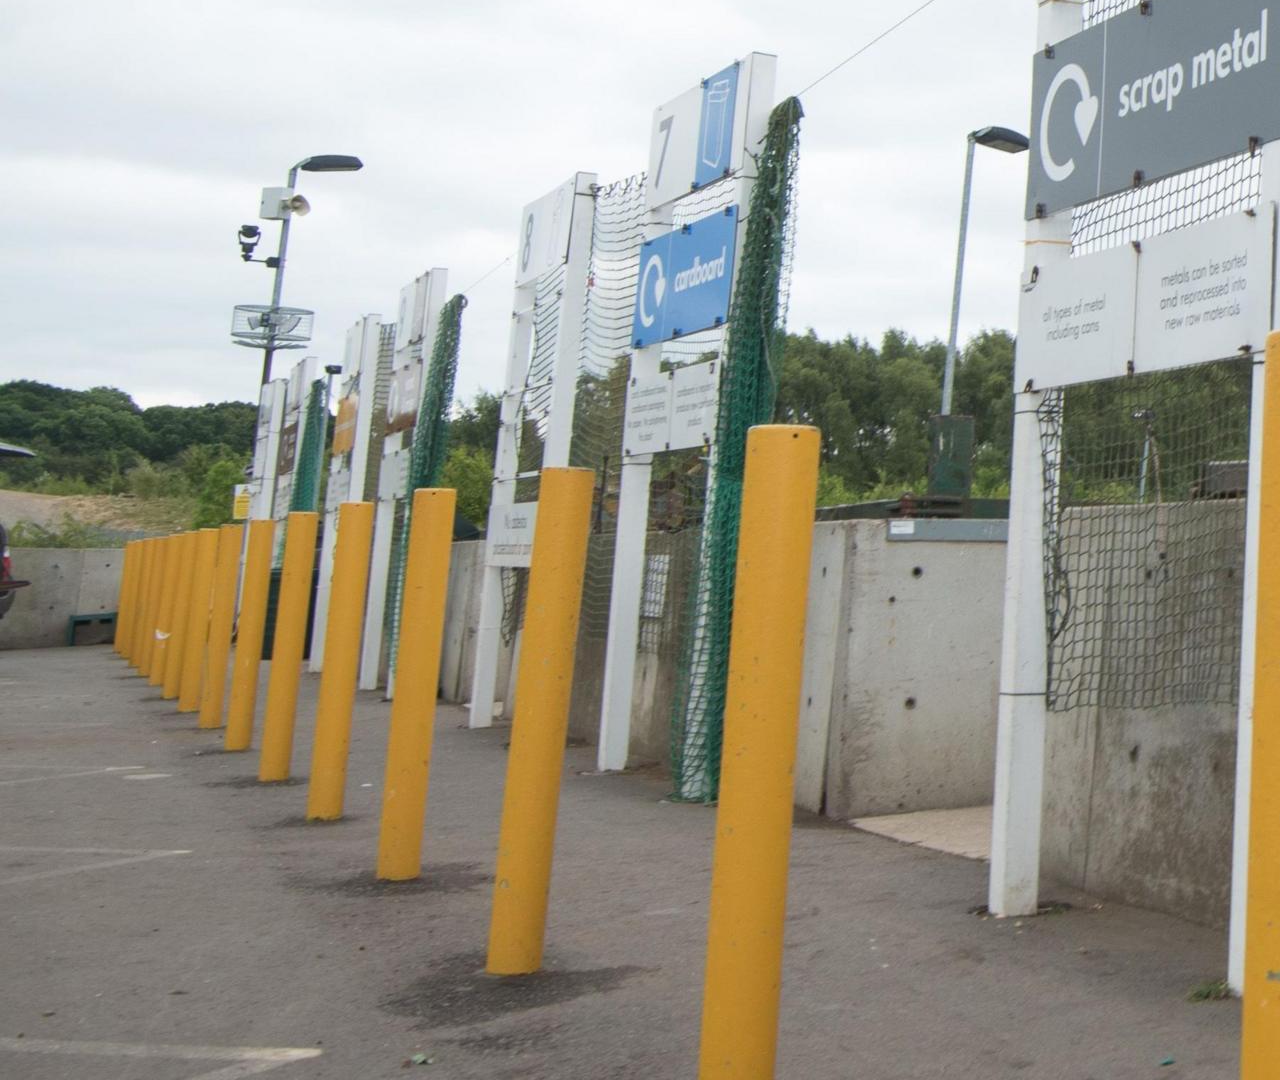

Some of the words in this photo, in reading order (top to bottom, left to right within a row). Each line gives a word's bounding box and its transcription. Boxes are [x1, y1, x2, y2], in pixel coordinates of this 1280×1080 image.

[1118, 62, 1184, 118] scrap
[1191, 8, 1268, 88] metal
[655, 114, 674, 190] 7
[522, 211, 534, 273] 8
[674, 247, 727, 292] cardboard
[1161, 265, 1191, 287] metals
[1191, 265, 1208, 281] can
[1208, 258, 1220, 275] be
[1221, 248, 1248, 273] sorted
[1042, 307, 1053, 322] all
[1054, 304, 1072, 323] types
[1074, 298, 1083, 316] of
[1083, 293, 1106, 312] metal
[1159, 293, 1178, 311] and
[1180, 280, 1230, 307] reprocessed
[1230, 275, 1247, 293] into
[1046, 322, 1079, 340] including
[1081, 320, 1100, 335] cans
[1164, 316, 1182, 330] new
[1184, 313, 1201, 327] raw
[1203, 301, 1241, 324] materials
